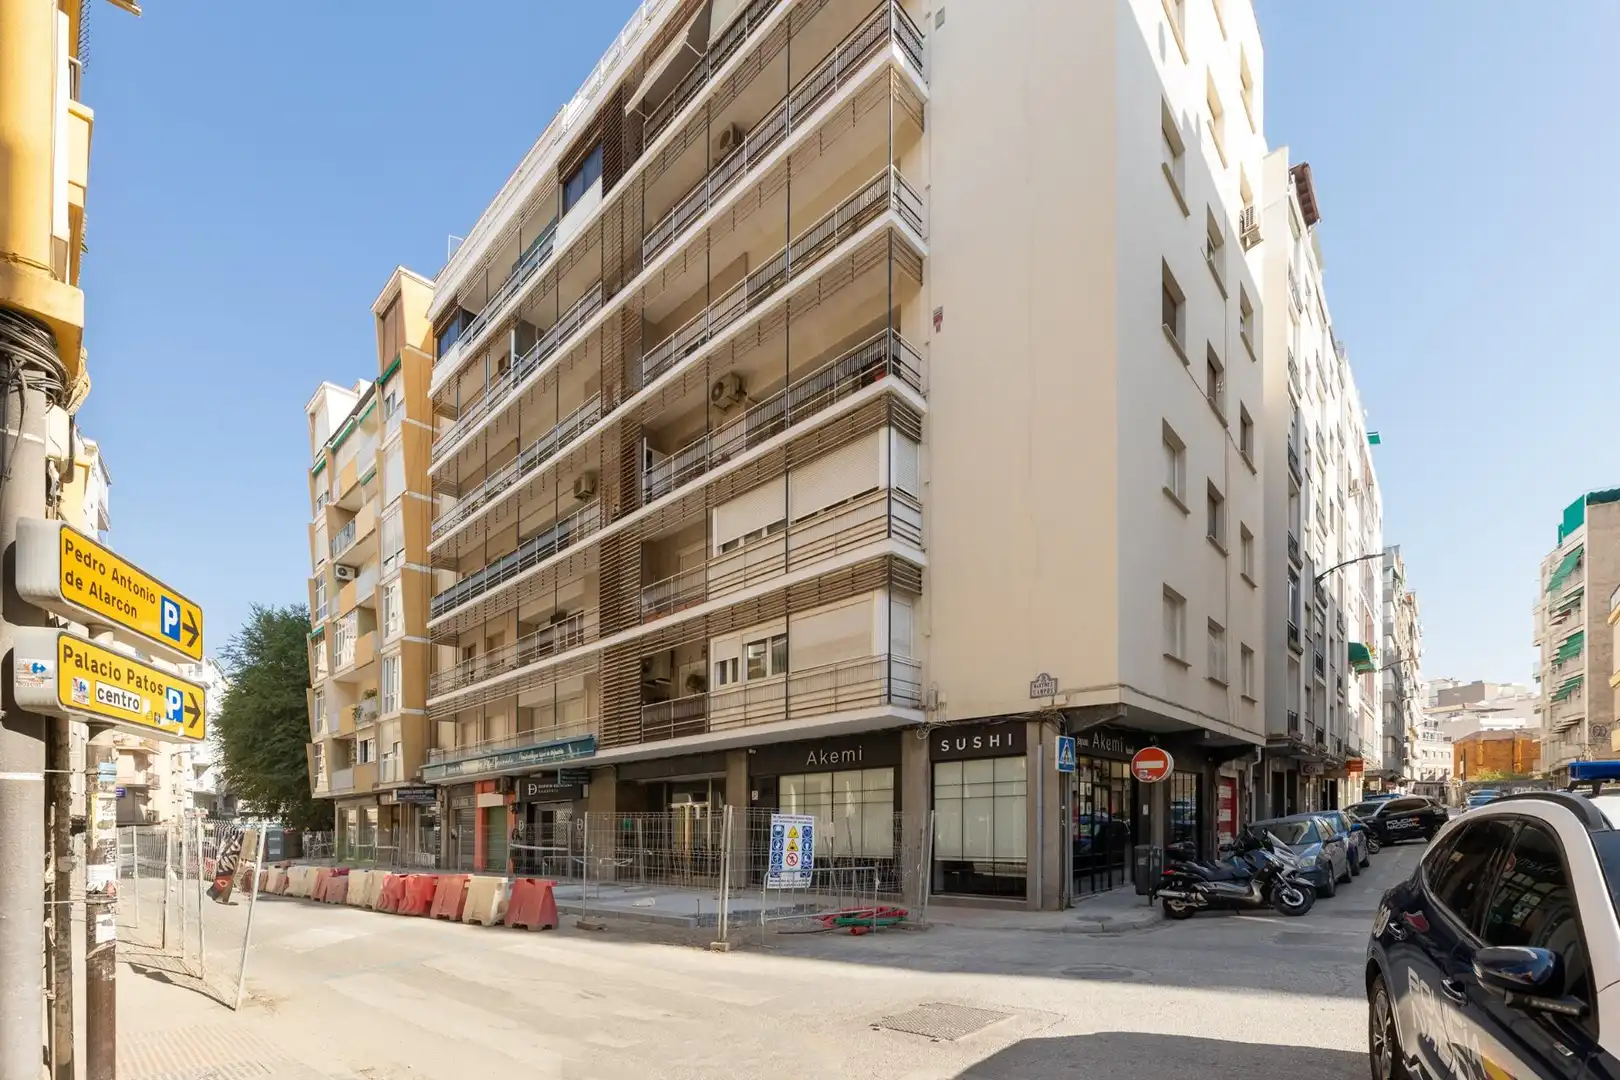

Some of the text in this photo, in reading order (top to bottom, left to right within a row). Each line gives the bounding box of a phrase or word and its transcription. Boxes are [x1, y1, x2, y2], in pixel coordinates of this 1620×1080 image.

[65, 538, 156, 605] Pedro Antonio
[65, 570, 138, 619] de Alarcón
[164, 600, 178, 635] P
[63, 644, 164, 696] Palacio Patos
[97, 686, 140, 711] centro
[806, 746, 864, 766] Akemi
[941, 733, 1013, 752] SUSHI
[1092, 731, 1123, 753] Akemi
